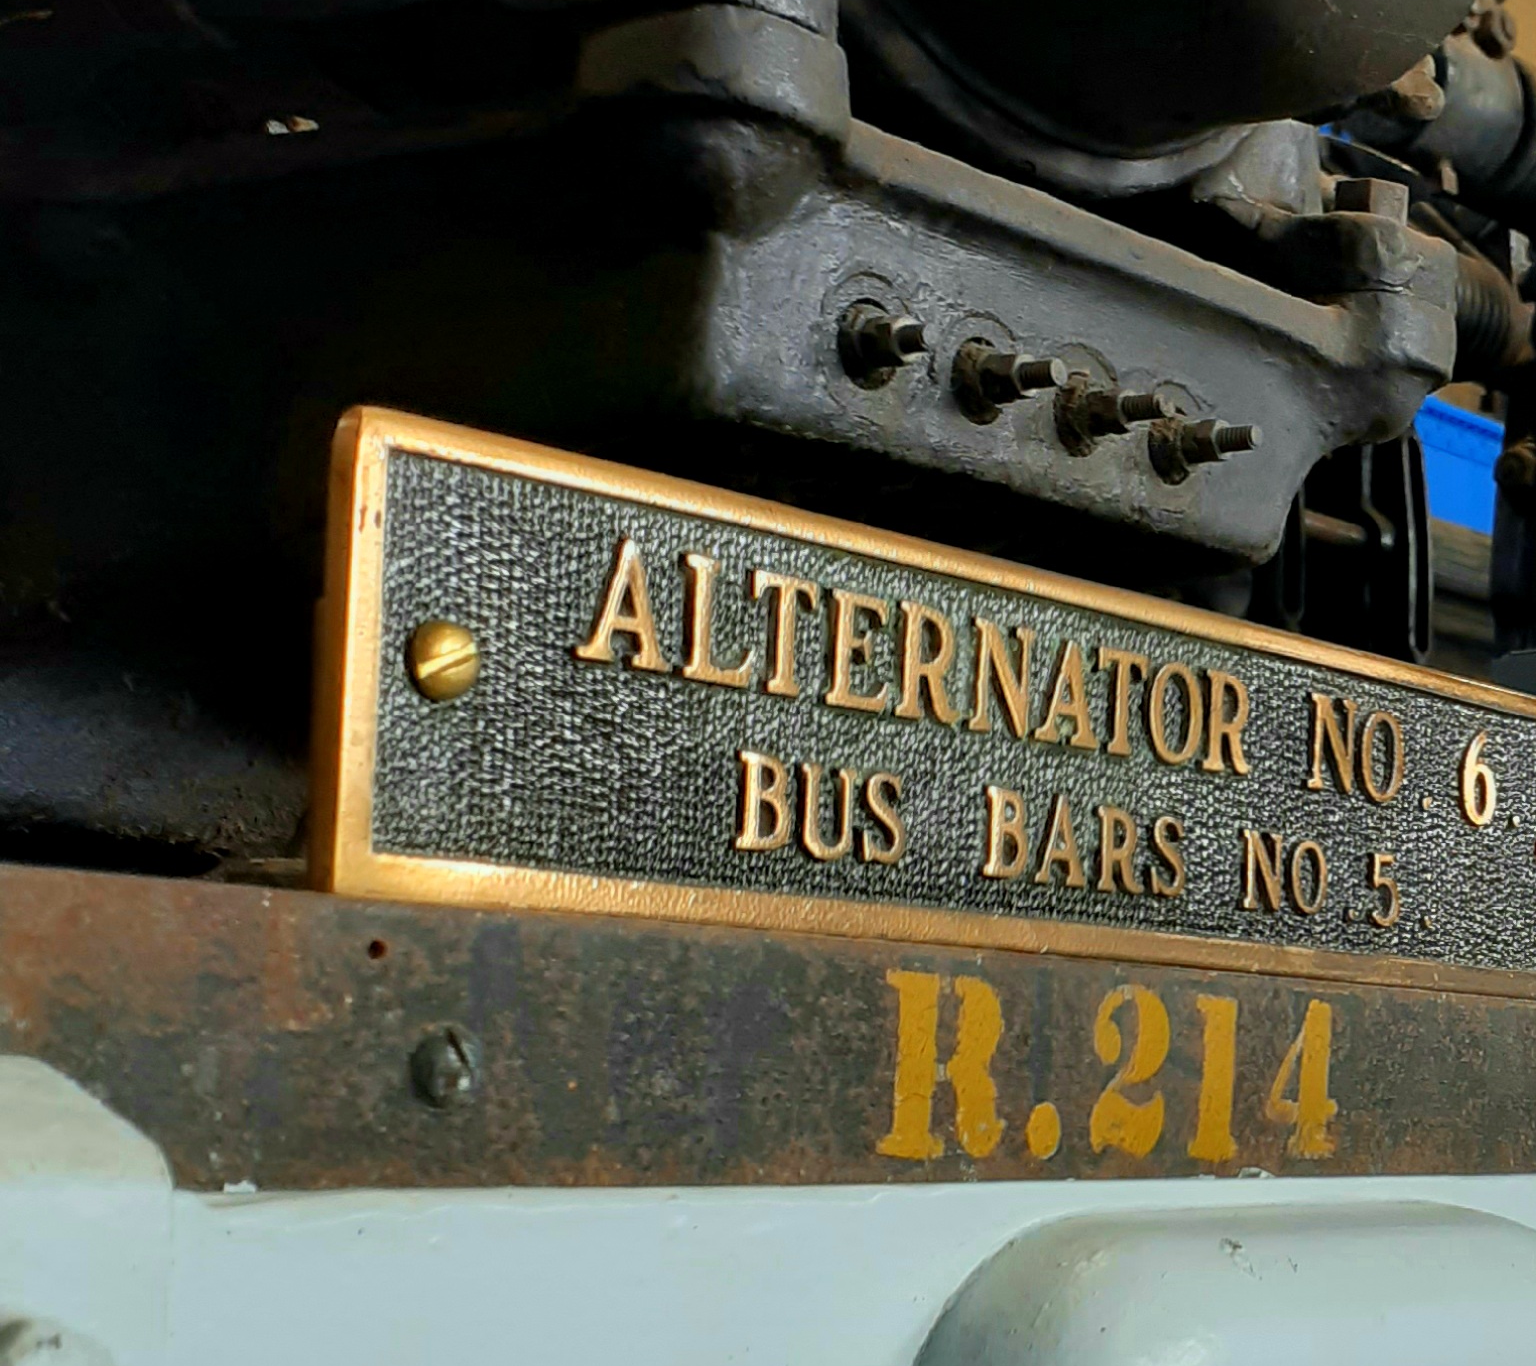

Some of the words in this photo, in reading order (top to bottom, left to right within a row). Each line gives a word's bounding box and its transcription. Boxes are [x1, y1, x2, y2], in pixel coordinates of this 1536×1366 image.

[574, 537, 1250, 776] ALTERNATOR
[735, 749, 906, 864] BUS
[982, 785, 1187, 898] BARS
[876, 968, 1338, 1163] R.214
